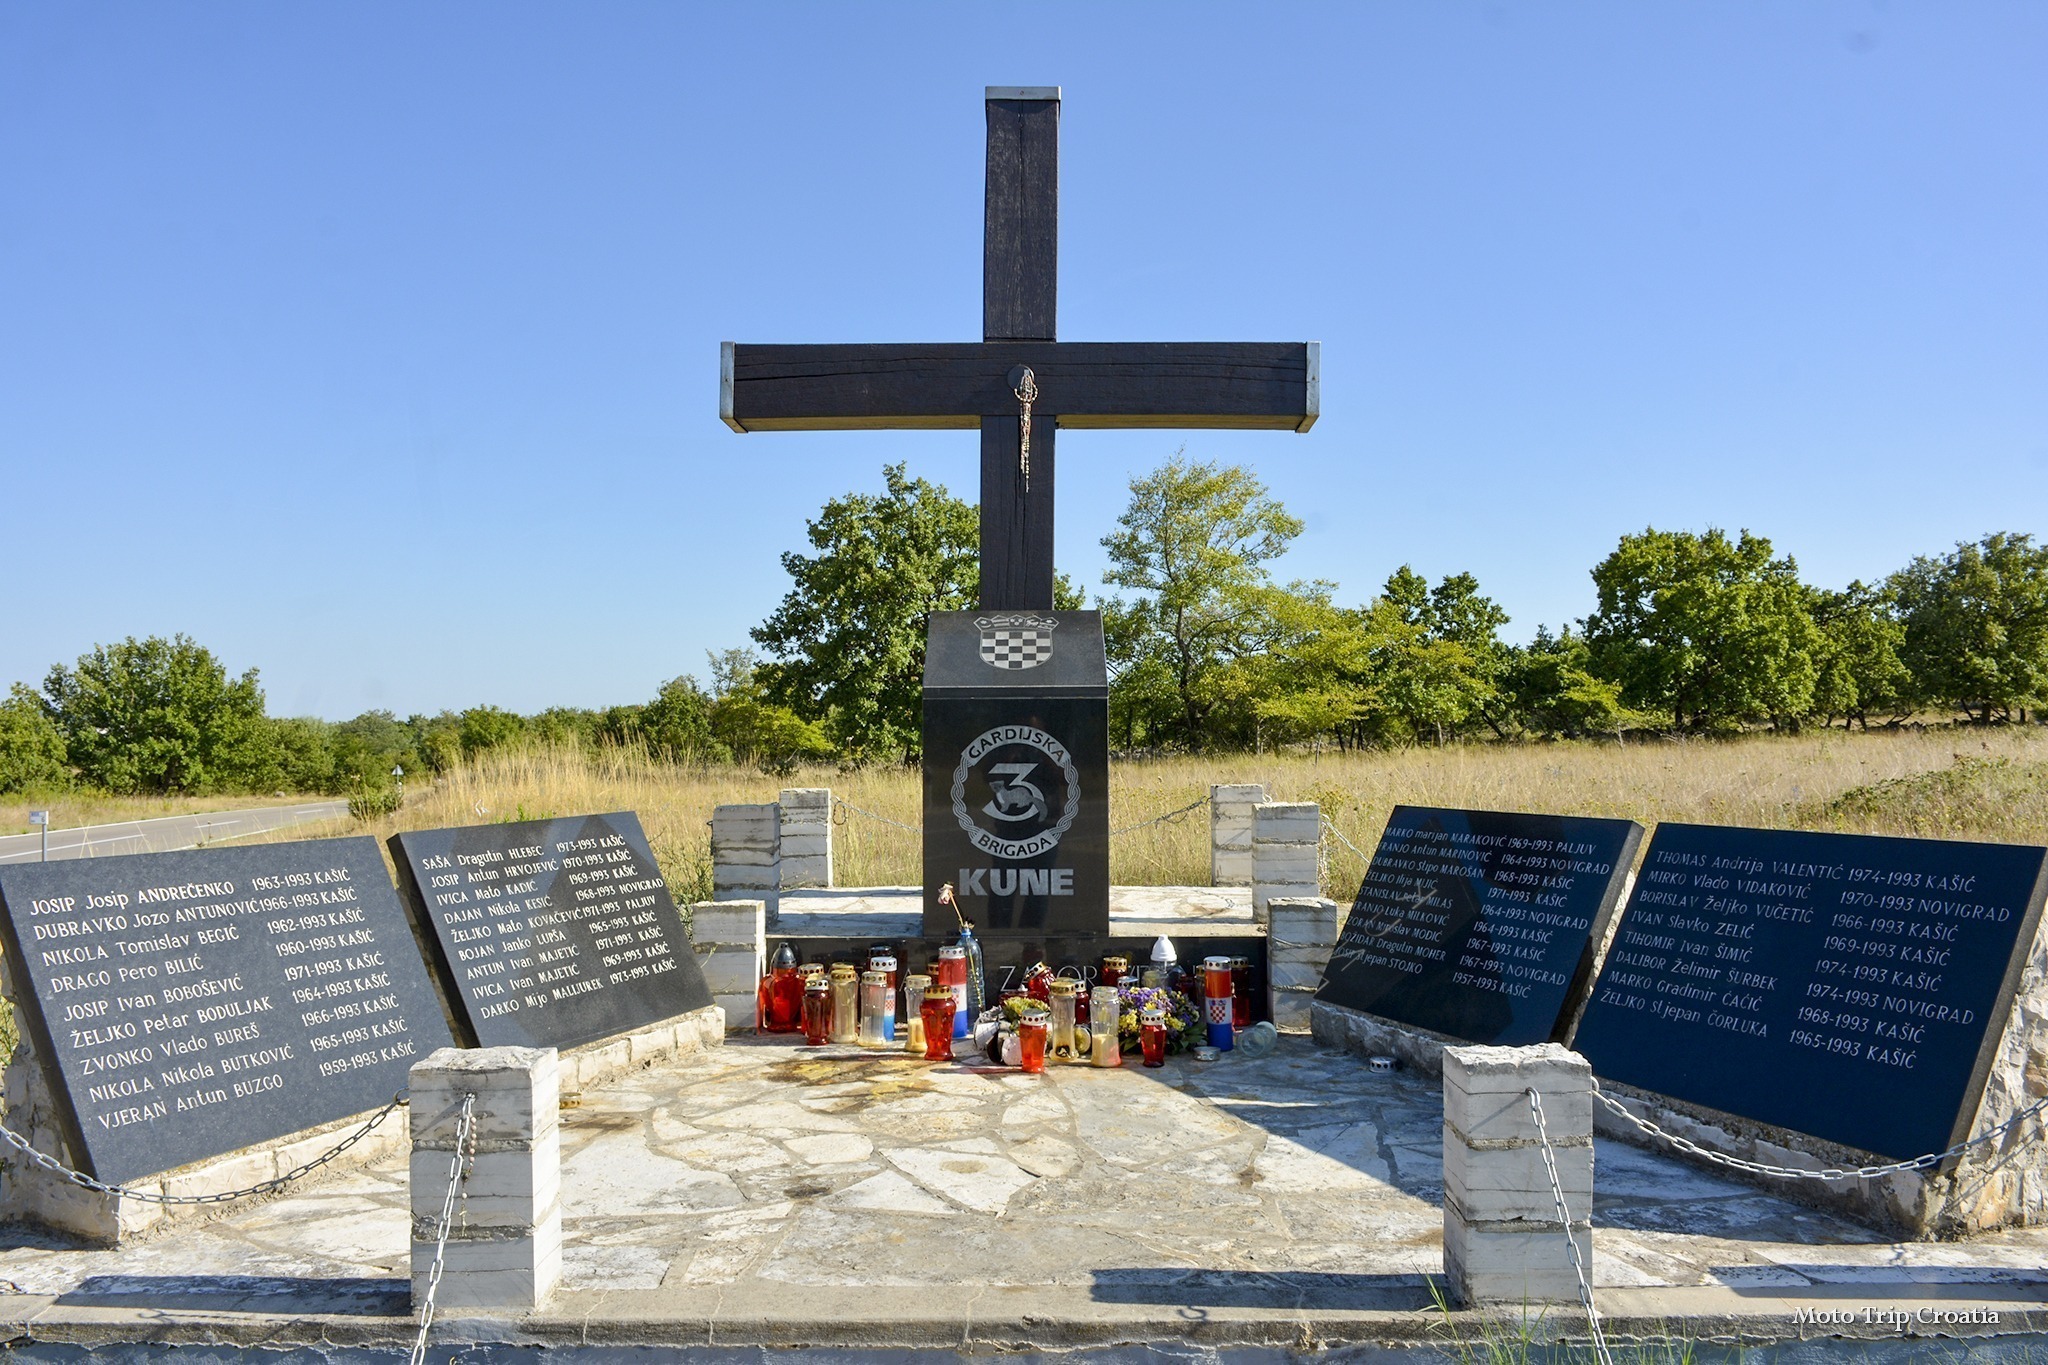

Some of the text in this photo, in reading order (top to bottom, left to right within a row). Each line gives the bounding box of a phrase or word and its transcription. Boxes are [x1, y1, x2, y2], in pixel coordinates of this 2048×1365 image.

[969, 727, 1066, 763] GARDIJSKA
[982, 763, 1045, 822] 3
[422, 854, 452, 870] SAŠA
[456, 849, 504, 867] Dragutin
[556, 838, 597, 853] 1973-1993
[599, 833, 626, 848] KAŠIĆ
[431, 848, 632, 888] JOSIP Antun HRVOJEVIĆ 1970-1993 KAŠIĆ
[978, 834, 1053, 858] BRIGADA
[1656, 850, 1976, 893] THOMAS Andrija VALENTIĆ 1974-1993 KAŠIĆ
[30, 866, 351, 916] JOSIP Josip ANDREČENKO 1963-1993 KAŠIĆ
[436, 863, 638, 906] IVICA Mato KADIĆ 1969-1993 KAŠIĆ
[443, 907, 483, 924] DAJAN
[487, 900, 521, 917] Nikola
[575, 884, 616, 901] 1968-1993
[618, 877, 664, 894] NOVIGRAD
[959, 868, 1074, 896] KUNE
[1647, 870, 2010, 922] MIRKO Vlado VIDAKOVIĆ 1970-1993 NOVIGRAD
[33, 885, 358, 940] DUBRAVKO Jozo ANTUNOVIĆ 1966-1993 KAŠIĆ
[42, 906, 365, 967] NIKOLA Tomislav BEGIĆ 1962-1993 KAŠIĆ
[450, 894, 656, 943] ŽELJKO Mato KOVAČEVIĆ 1971-1993 PALJUV
[458, 909, 658, 961] BOJAN Janko LUPŠA 1965-1993 KAŠIĆ
[1631, 910, 1951, 966] IVAN Slavko ZELIĆ 1969-1993 KAŠIĆ
[1639, 890, 1959, 942] BORISLAV Željko VUČETIĆ 1966-1993 KAŠIĆ
[50, 927, 375, 993] DRAGO Pero BILIĆ 1960-1993 KAŠIĆ
[467, 924, 664, 980] ANTUN Ivan MAJETIĆ 1971-1993 KAŠIĆ
[472, 940, 671, 999] IVICA Ivan MAJETIĆ 1969-1993 KAŠIĆ
[1625, 930, 1942, 992] TIHOMIR Ivan ŠIMIĆ 1974-1993 KAŠIĆ
[63, 950, 385, 1022] JOSIP Ivan BOBOŠEVIĆ 1971-1993 KAŠIĆ
[69, 971, 391, 1048] ŽELJKO Petar BODULJAK 1964-1993 KAŠIĆ
[480, 956, 677, 1019] DARKO Mijo 1973-1993 KAŠIĆ
[1607, 970, 1926, 1044] MARKO Gradimir 1968-1993 KAŠIĆ
[1615, 950, 1974, 1025] DALIBOR Želimir ŠURBEK 1974-1993 NOVIGRAD
[79, 992, 399, 1075] ZVONKO Vlado BUREŠ 1966-1993 KAŠIĆ
[1600, 987, 1917, 1069] ŽELJKO Stjepan ČORLUKA 1965-1993 KAŠIĆ
[89, 1015, 408, 1103] NIKOLA Nikola BUTKOVIĆ 1965-1993 KAŠIĆ
[97, 1038, 417, 1129] VJERAN Antun BUZGO 1959-1993 KAŠIĆ
